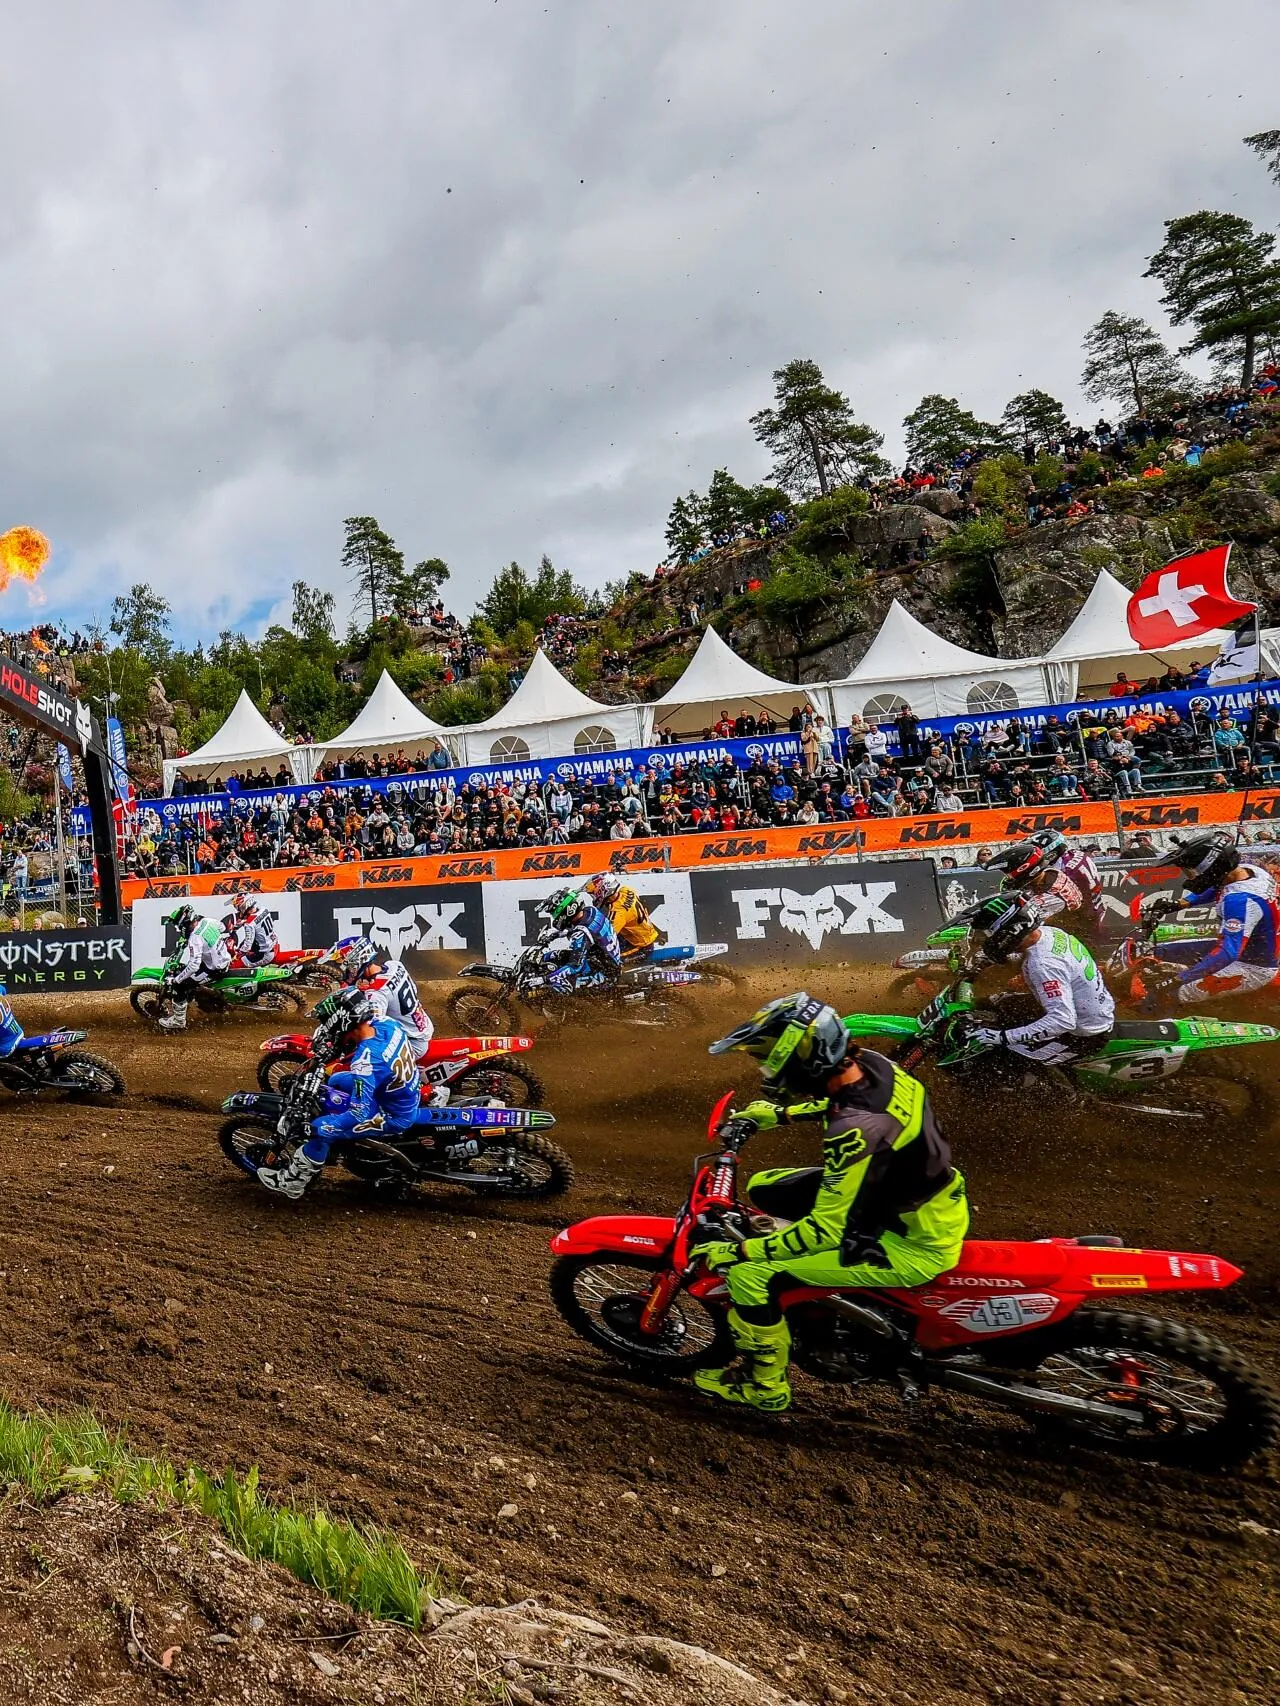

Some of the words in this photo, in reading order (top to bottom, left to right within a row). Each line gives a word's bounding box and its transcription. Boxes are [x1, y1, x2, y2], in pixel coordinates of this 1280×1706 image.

[1, 665, 72, 727] HOLESHOT
[574, 757, 634, 776] YAMAHA
[665, 748, 727, 766] YAMAHA
[485, 766, 542, 786] YAMAHA
[176, 799, 223, 816] YAMAHA
[1122, 803, 1199, 826] KTM
[899, 819, 971, 843] KTM
[1006, 813, 1081, 835] KTM
[700, 837, 767, 859] KTM
[797, 829, 867, 852] KTM
[521, 851, 581, 872] KTM
[609, 844, 672, 866] KTM
[362, 864, 413, 884] KTM
[437, 858, 493, 878] KTM
[143, 882, 189, 898] KTM
[212, 876, 262, 896] KTM
[285, 871, 336, 891] KTM
[730, 882, 904, 950] FOX
[333, 903, 467, 965] FOX
[802, 1001, 822, 1020] FOX
[425, 1065, 447, 1084] 61
[1129, 1056, 1165, 1080] 3
[445, 1140, 479, 1160] 259
[623, 1235, 656, 1246] MOTUL
[764, 1217, 830, 1261] FOX
[947, 1276, 1025, 1288] HONDA
[969, 1296, 1021, 1327] 43
